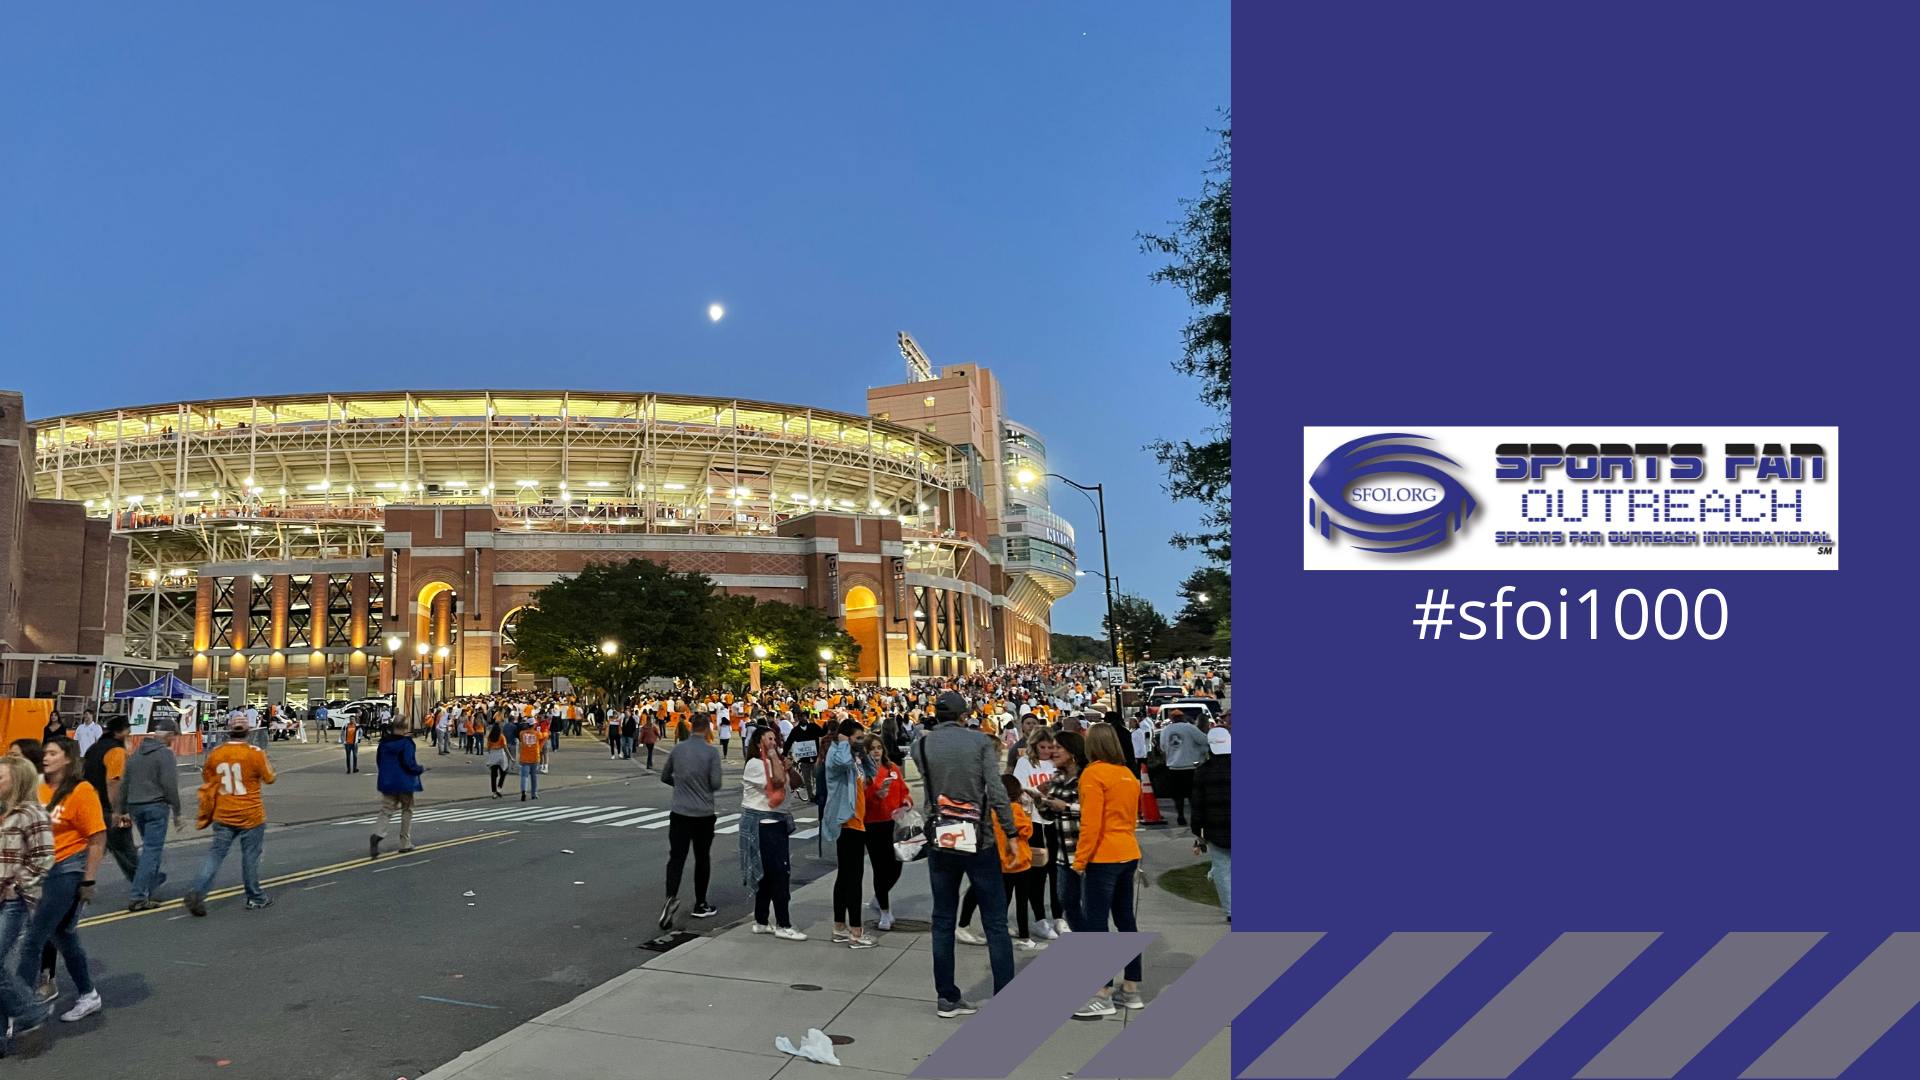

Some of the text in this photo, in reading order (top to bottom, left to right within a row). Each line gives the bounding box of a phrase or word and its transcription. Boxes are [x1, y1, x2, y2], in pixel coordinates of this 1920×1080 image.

[516, 539, 787, 551] NEYLAND STADIUM
[1110, 676, 1123, 684] 25
[216, 762, 248, 796] 31
